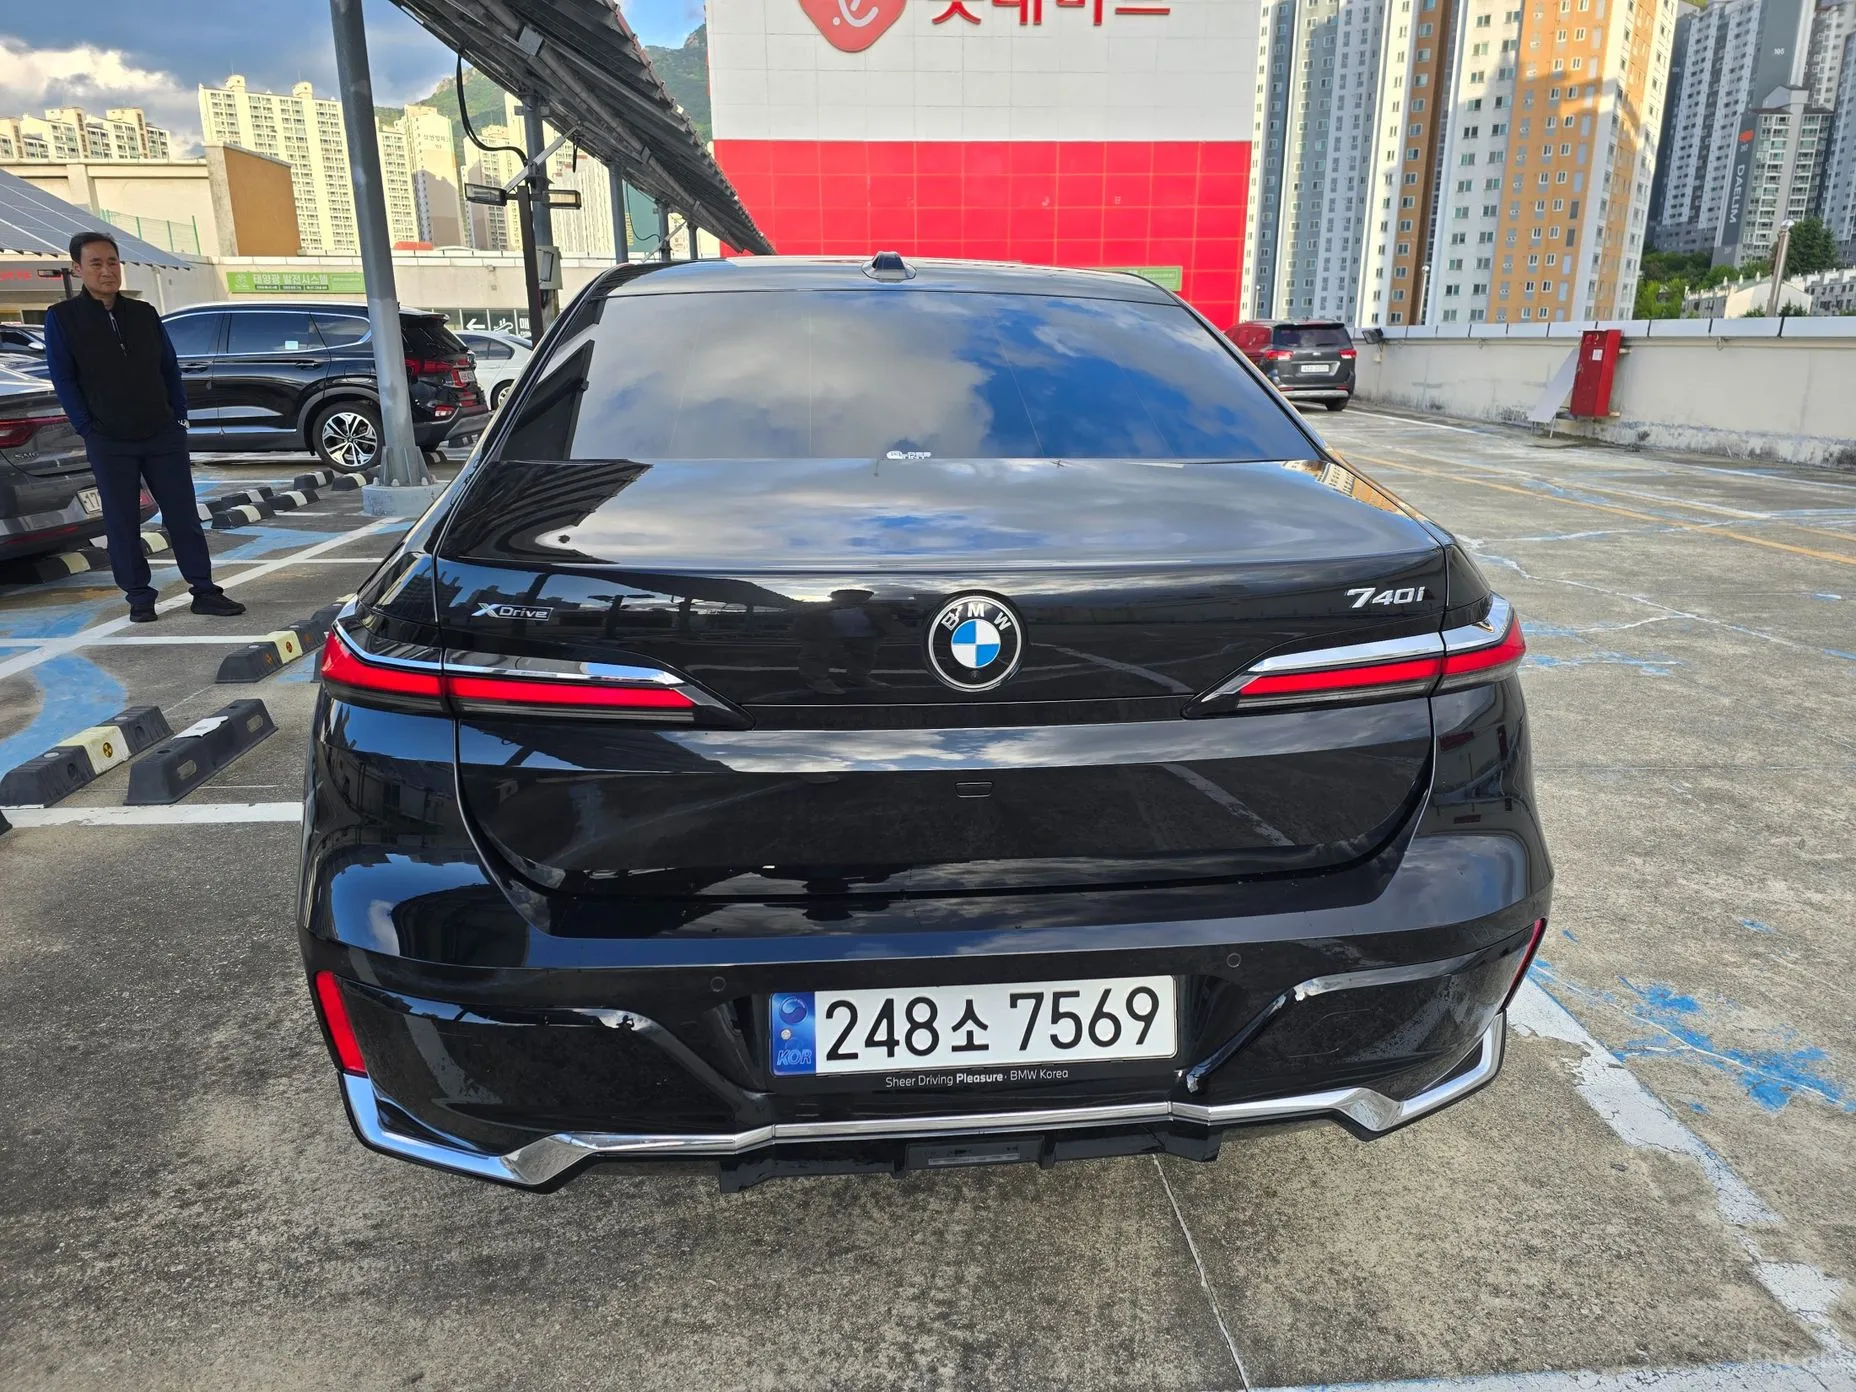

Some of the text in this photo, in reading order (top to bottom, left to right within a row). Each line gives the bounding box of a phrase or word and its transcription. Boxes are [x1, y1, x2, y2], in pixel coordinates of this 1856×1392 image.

[1729, 164, 1745, 223] DAELIM
[1346, 586, 1426, 608] 740i
[941, 602, 1012, 631] BMW
[826, 986, 1160, 1061] 248소 7569
[776, 1048, 813, 1066] KOR
[885, 1069, 1069, 1088] Sheer Driving Pleasure BMW Korea
